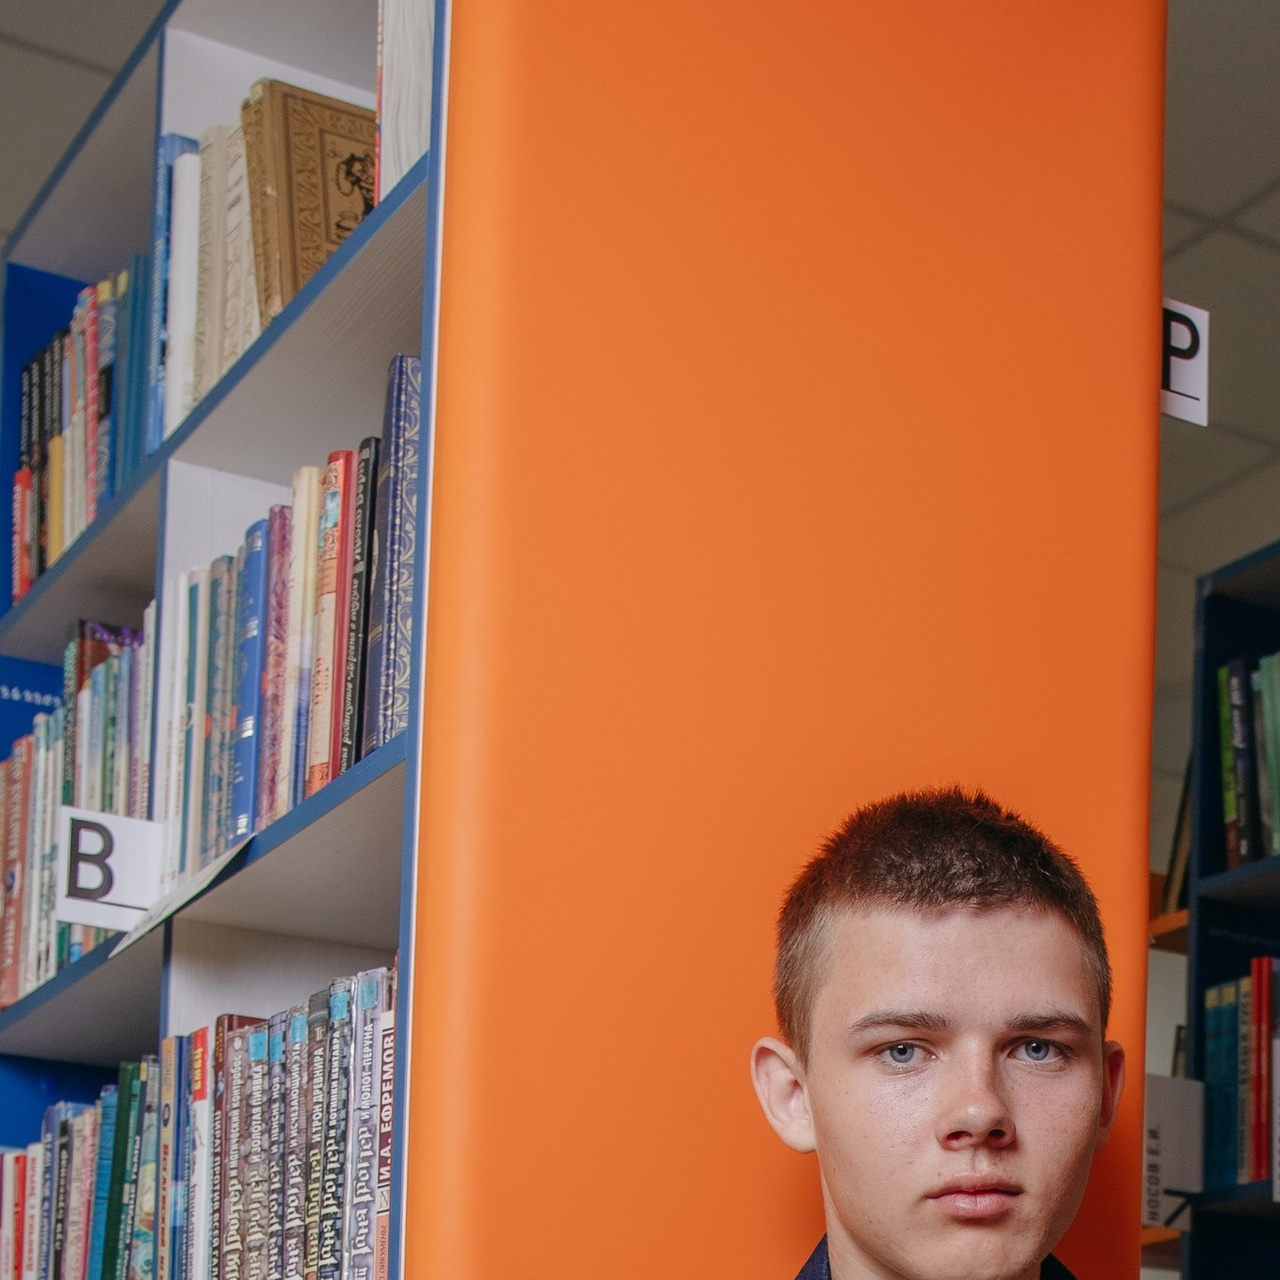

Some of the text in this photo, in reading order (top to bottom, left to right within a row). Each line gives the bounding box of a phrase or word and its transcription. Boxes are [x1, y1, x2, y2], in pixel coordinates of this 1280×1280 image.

[1162, 307, 1200, 391] Р
[67, 817, 114, 901] В
[291, 1043, 302, 1063] ЭТА
[313, 1046, 326, 1103] ДРЕВНИРА
[331, 1030, 342, 1080] КЕНТАВРА
[231, 1054, 245, 1108] контрабас
[252, 1064, 264, 1107] ПИЯВКА
[290, 1064, 303, 1136] ИСЧЕЗАЮЩИЙ
[329, 1079, 340, 1127] БОТИНКИ
[380, 1034, 394, 1133] ЕФРЕМОВ
[229, 1107, 241, 1168] магический
[251, 1107, 263, 1153] ЗОЛОТАЯ
[271, 1102, 281, 1141] ПЕНСНЕ
[312, 1104, 324, 1132] ТРОН
[213, 1157, 222, 1212] ПРОТИВ
[351, 1125, 375, 1207] Гроттер
[212, 1215, 221, 1248] ВСЕЙ
[350, 1208, 374, 1268] Таня
[378, 1225, 388, 1275] ОЙКУМЕНЫ
